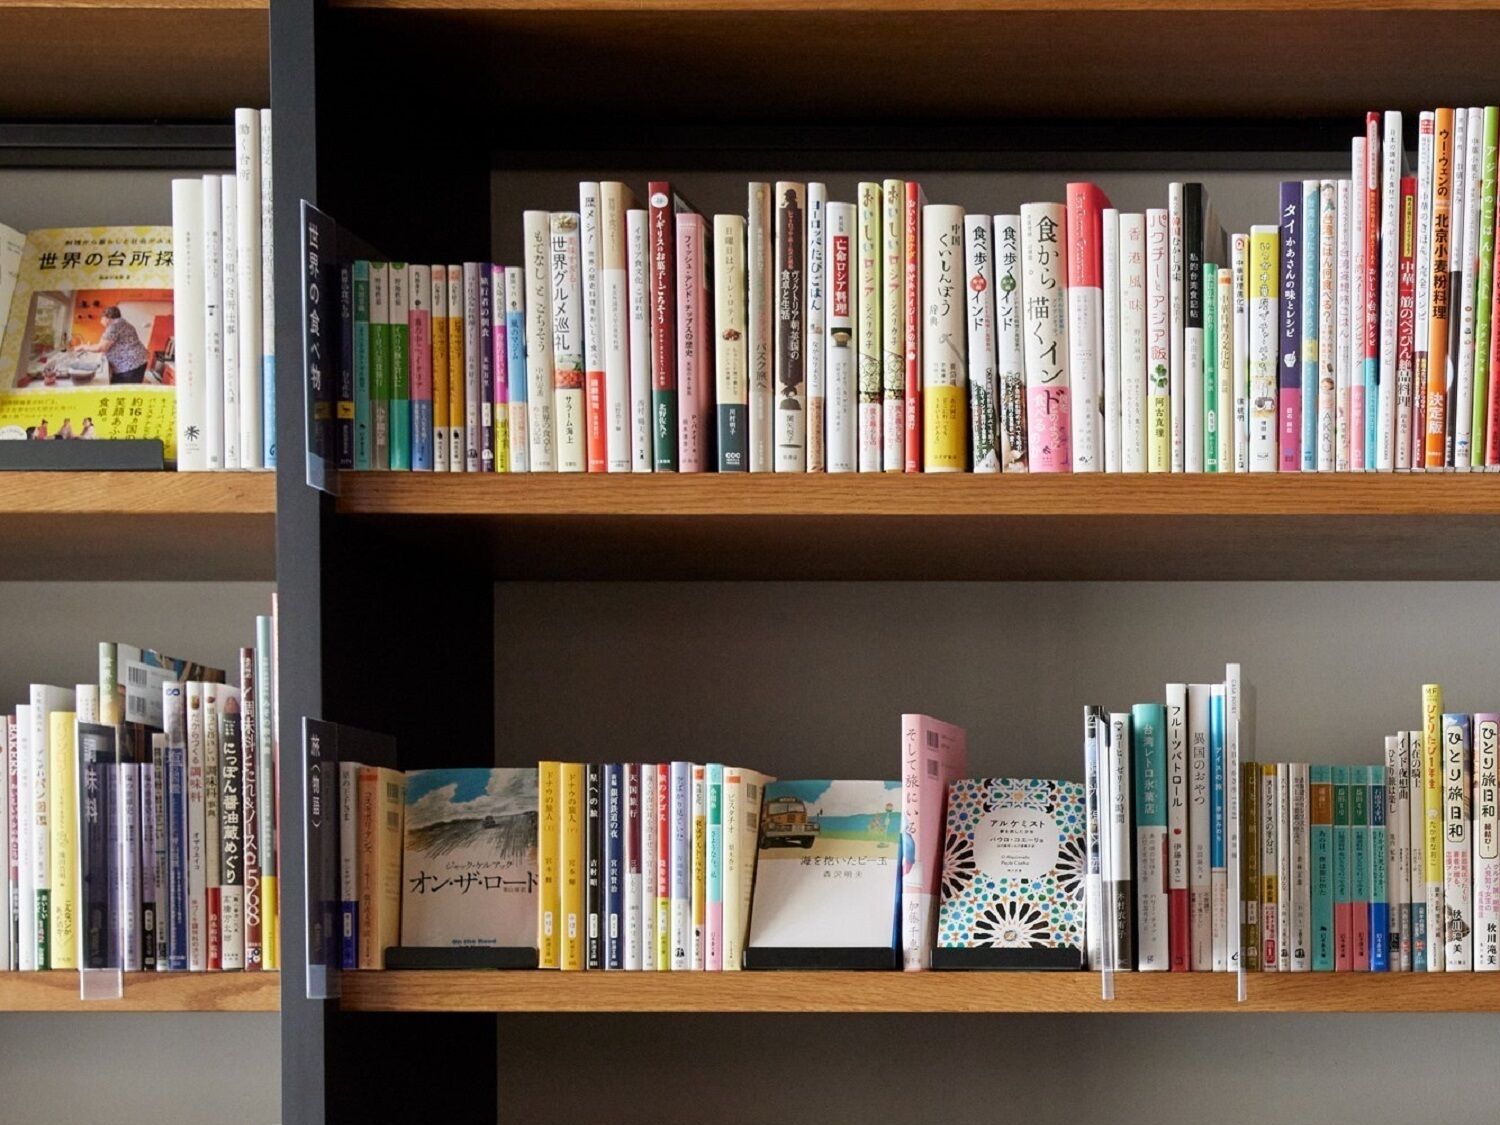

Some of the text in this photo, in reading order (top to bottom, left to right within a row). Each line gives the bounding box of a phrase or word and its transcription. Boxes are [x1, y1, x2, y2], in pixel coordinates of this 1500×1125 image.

[308, 222, 323, 392] 世界の食べ物
[552, 236, 570, 351] 世界グルメ巡礼
[834, 239, 849, 316] 亡命ロシア料理
[937, 233, 953, 316] くいしんぼう
[1283, 204, 1299, 339] タイかあさんの味とレシピ
[1434, 211, 1450, 320] 北京小麦粉料理
[904, 727, 921, 836] そして旅にいる
[1192, 731, 1207, 806] 異国のおやつ
[1447, 731, 1464, 838] ひとり旅日和
[1481, 727, 1498, 818] ひとり旅日和
[800, 856, 888, 868] 海を抱いたビー玉
[988, 817, 1047, 830] アルケミスト
[410, 871, 538, 894] オン・ザ・ロード
